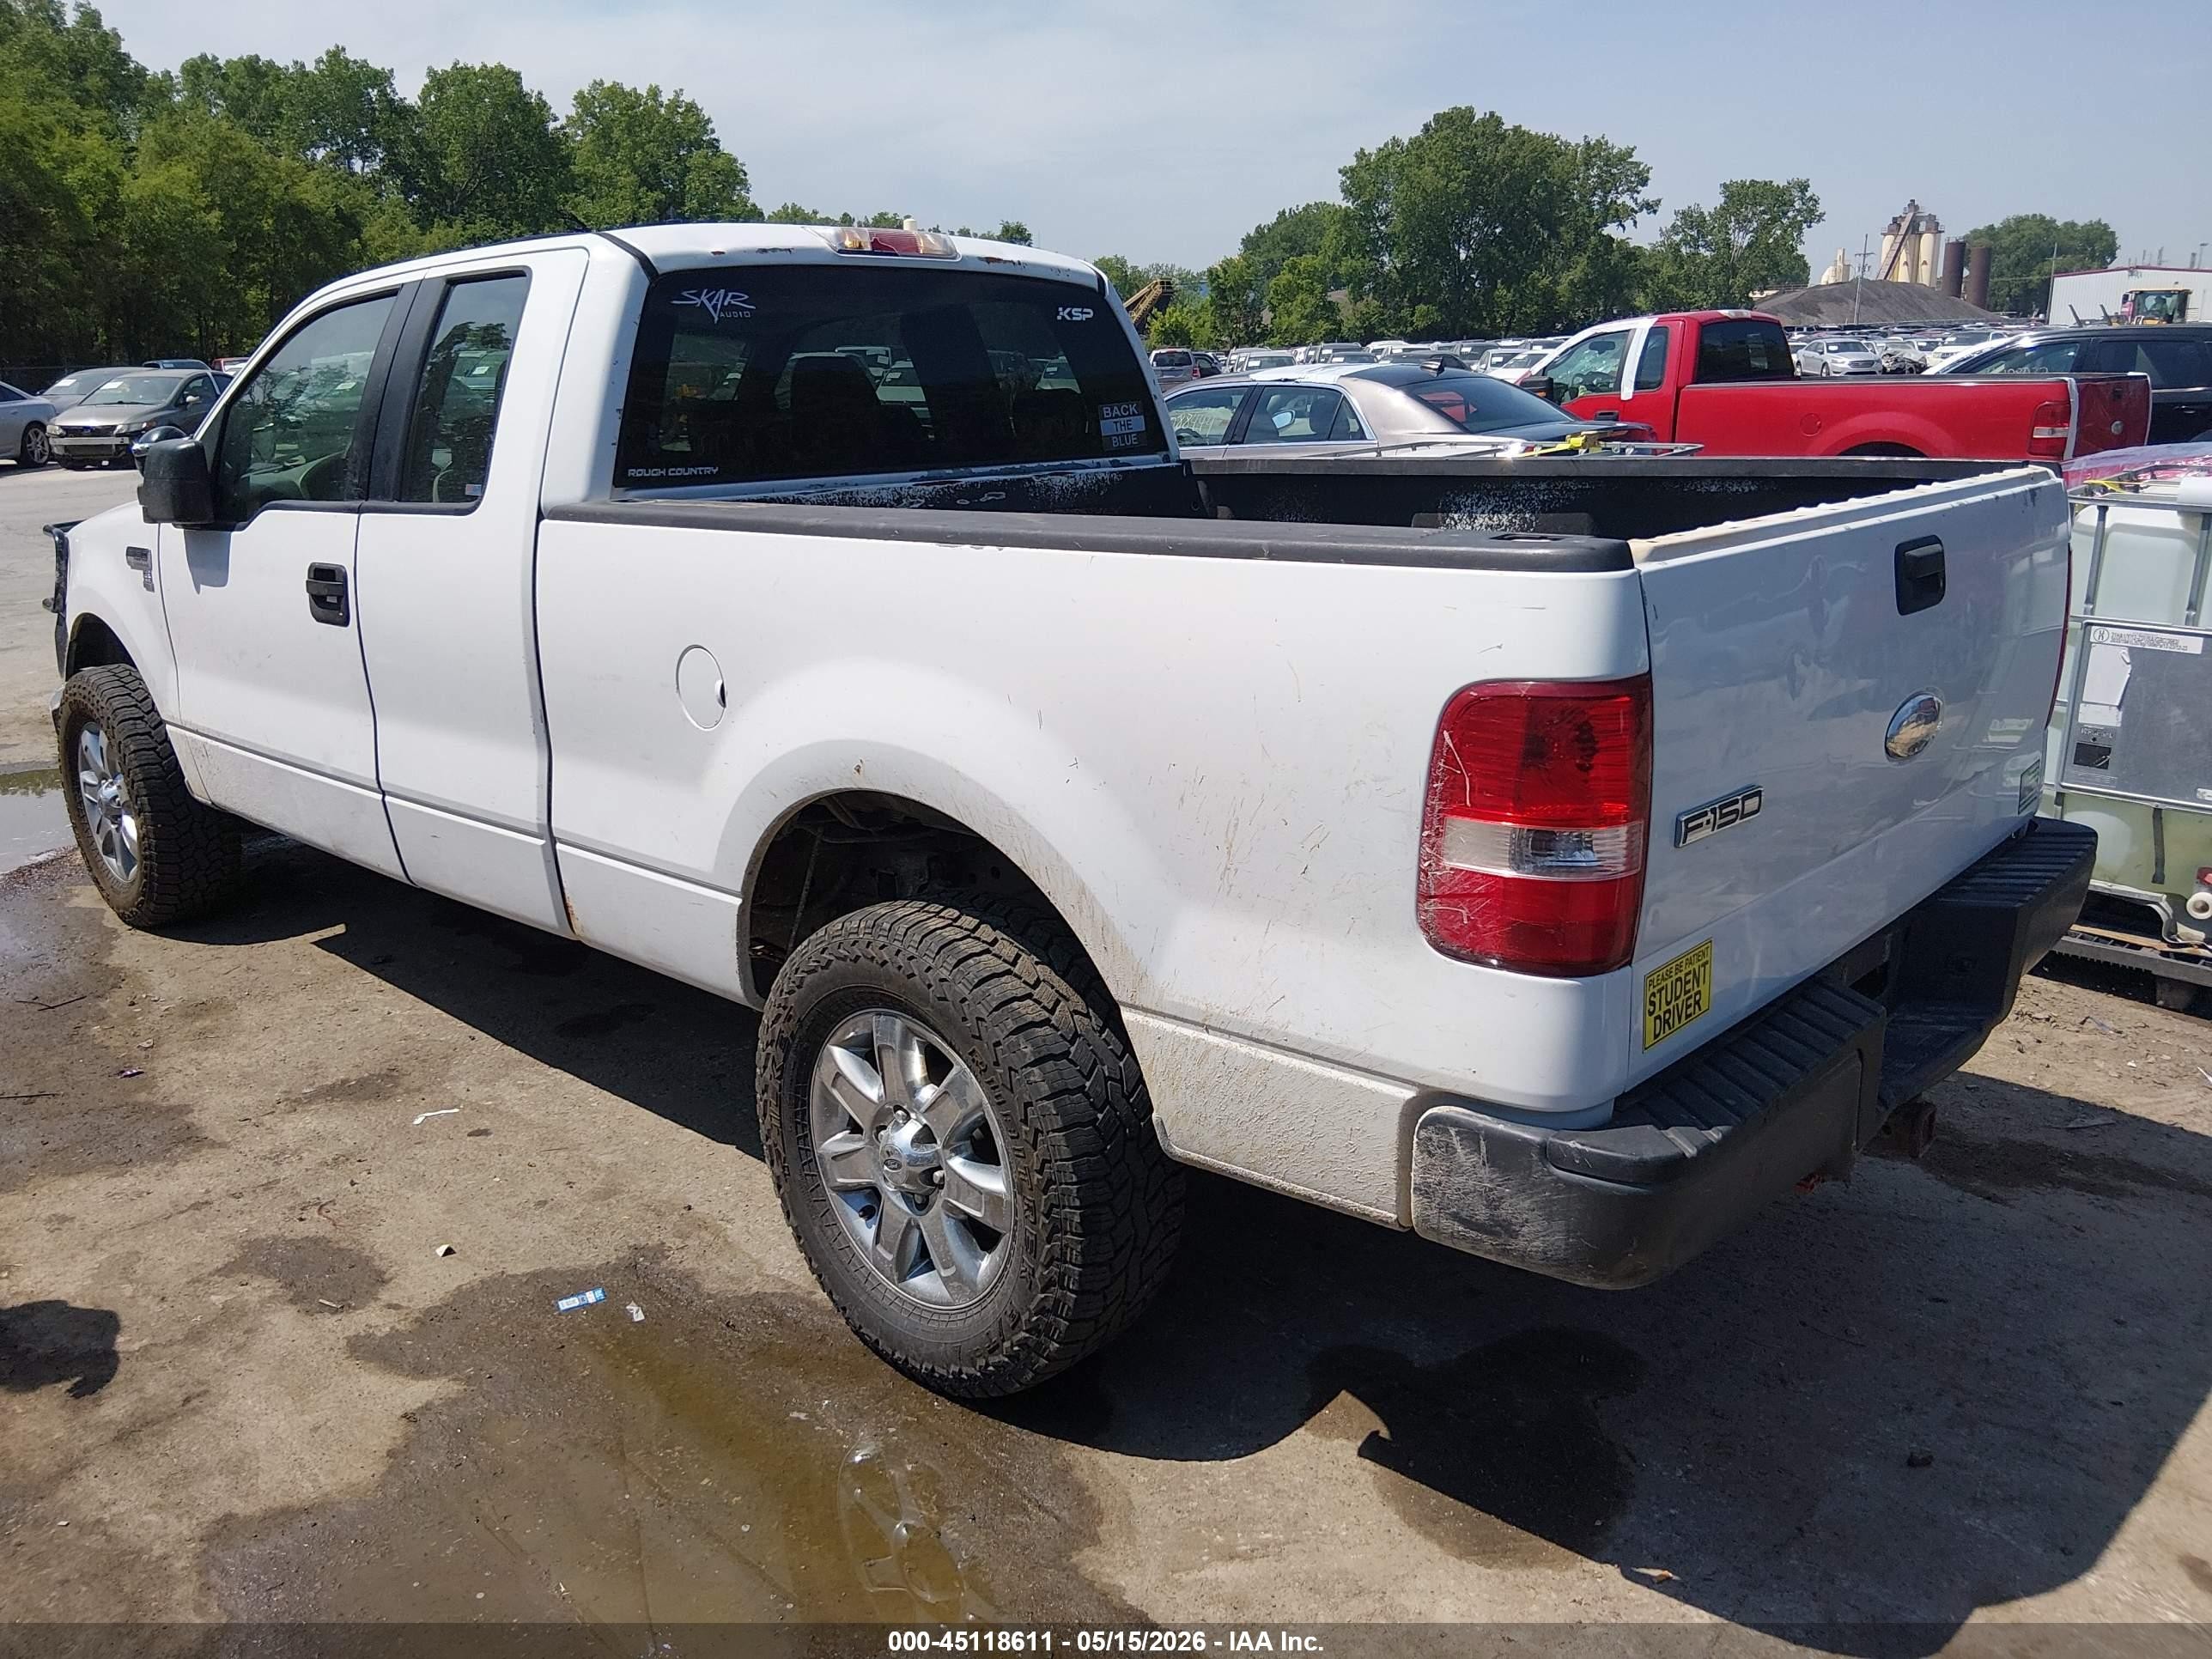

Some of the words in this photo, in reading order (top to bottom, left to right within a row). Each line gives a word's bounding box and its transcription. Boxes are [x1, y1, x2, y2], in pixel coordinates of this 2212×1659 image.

[670, 289, 757, 324] SKAR
[1057, 307, 1094, 320] KSP
[1103, 404, 1139, 418] BACK
[1113, 419, 1133, 433] THE
[1112, 434, 1139, 447] BLUE
[628, 468, 666, 477] ROUGH
[668, 466, 719, 476] COUNTRY
[1682, 789, 1763, 845] F-150
[1649, 966, 1674, 991] PLEASE
[1674, 962, 1685, 976] BE
[1684, 946, 1710, 969] PATIENT
[1648, 960, 1709, 1017] STUDENT
[1653, 989, 1702, 1041] DRIVER
